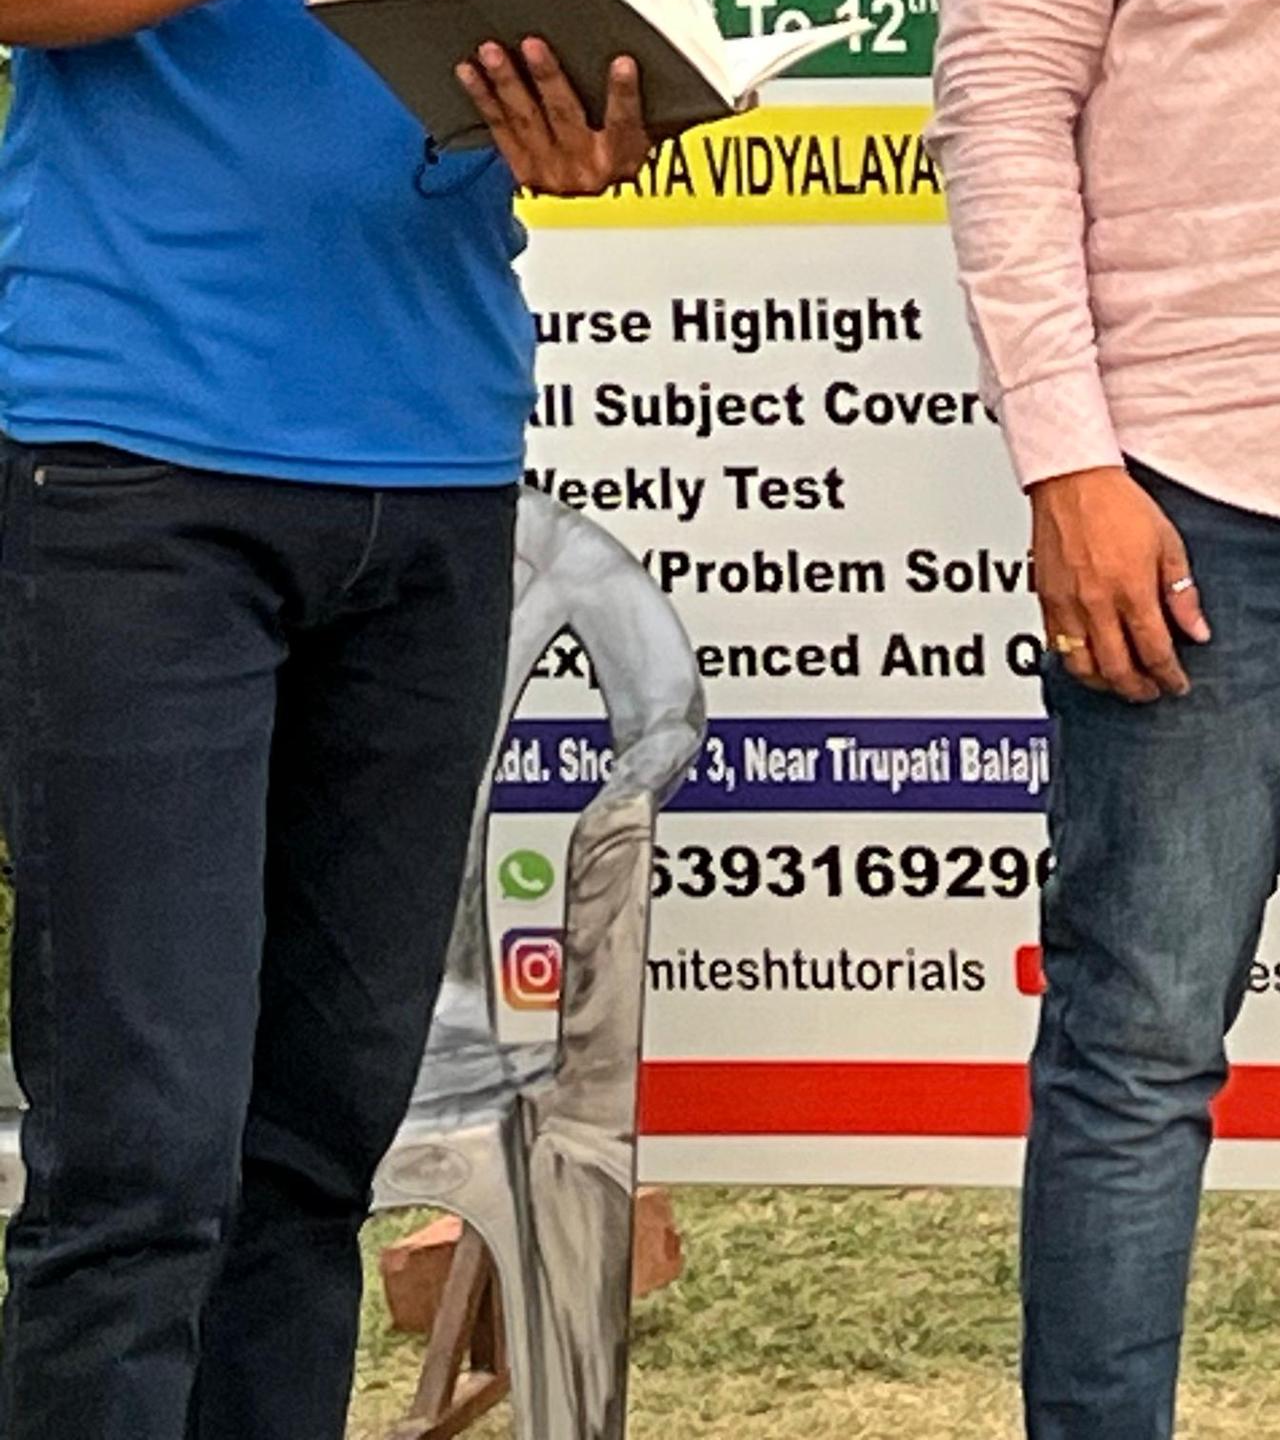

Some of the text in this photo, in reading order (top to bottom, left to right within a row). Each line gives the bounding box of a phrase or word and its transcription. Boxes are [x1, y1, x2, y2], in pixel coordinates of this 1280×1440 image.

[703, 134, 940, 197] VIDYALAYA
[533, 298, 922, 353] urse Highlight
[528, 383, 574, 428] ll
[594, 382, 806, 438] Subject
[723, 465, 846, 510] Test
[880, 634, 986, 678] And
[494, 736, 550, 783] dd.
[744, 736, 820, 783] Near
[826, 735, 950, 796] Tirupati
[960, 736, 1050, 796] Balaji
